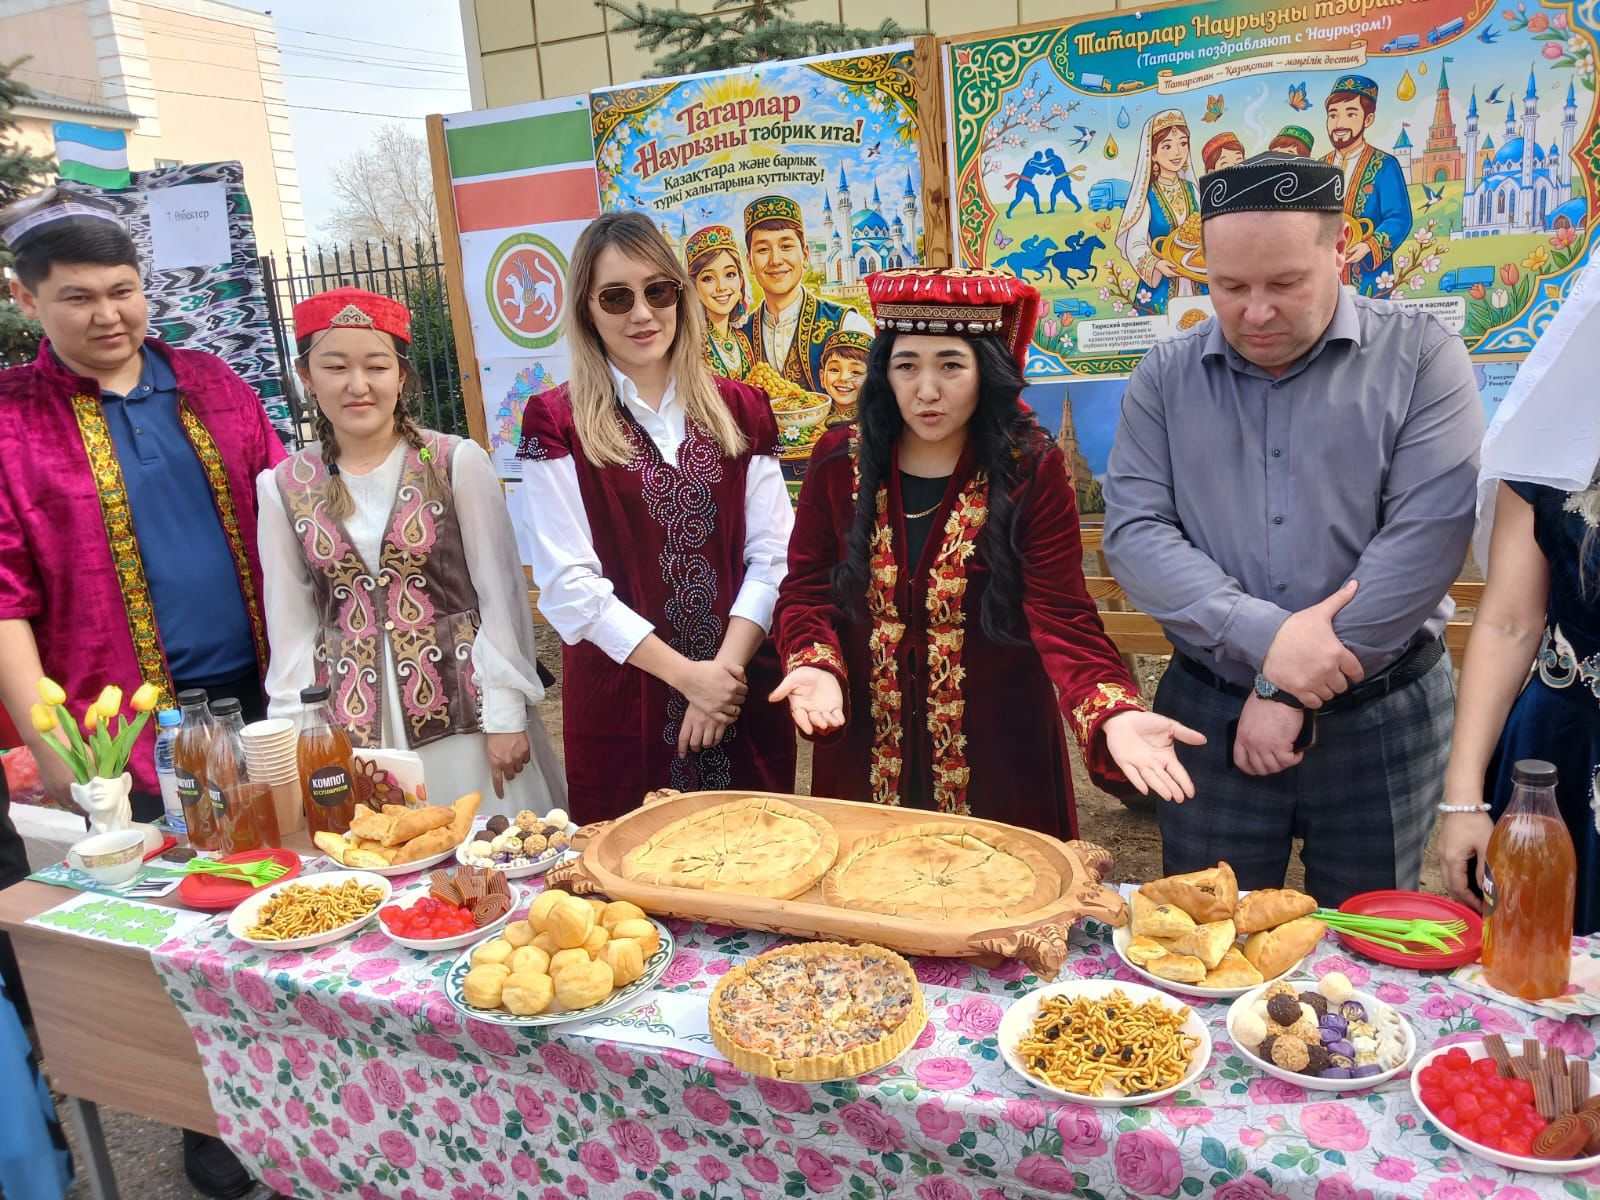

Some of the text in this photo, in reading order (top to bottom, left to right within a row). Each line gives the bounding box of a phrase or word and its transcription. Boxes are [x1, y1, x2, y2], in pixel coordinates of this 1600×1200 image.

[1074, 25, 1187, 55] Татарлар
[1191, 4, 1308, 38] Наурызны
[1136, 15, 1392, 69] (Татары поздравляют с Наурызом!)
[1163, 73, 1214, 90] Татарстан
[675, 95, 801, 136] Татарлар
[749, 121, 816, 144] тәбрик
[820, 119, 864, 143] ита!
[738, 157, 771, 172] және
[312, 773, 346, 789] КОМПОТ
